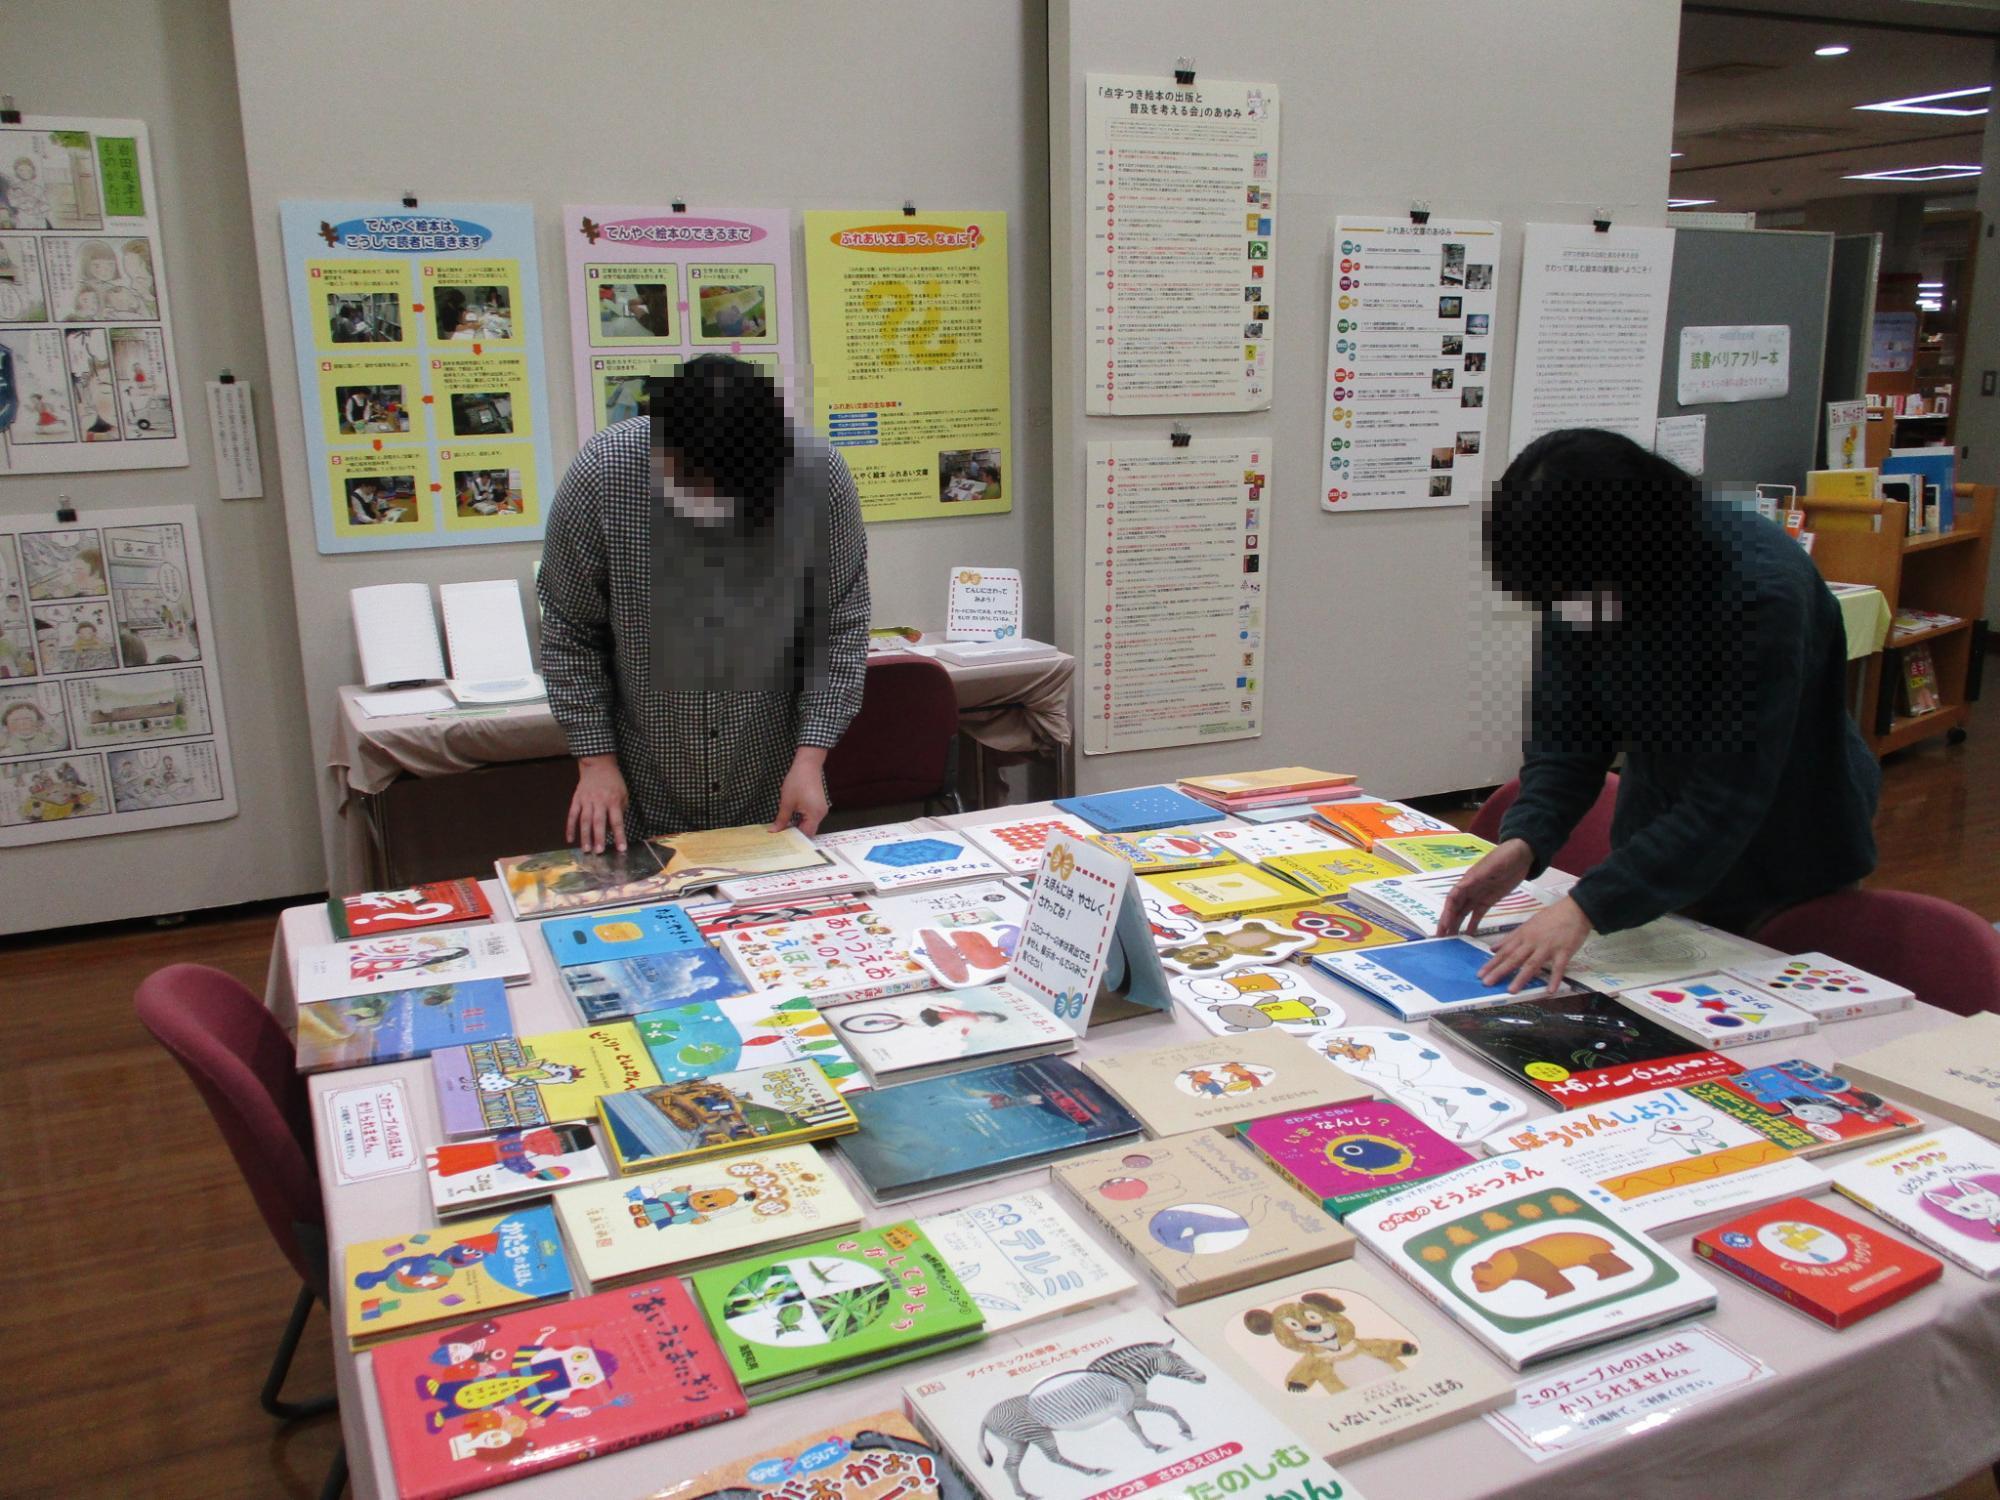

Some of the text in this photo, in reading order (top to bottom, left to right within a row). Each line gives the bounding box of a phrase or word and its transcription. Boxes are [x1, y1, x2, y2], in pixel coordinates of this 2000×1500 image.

[1099, 87, 1203, 103] 「点字つき絵本の出版と
[1130, 104, 1242, 118] 普及を考える会」のあゆみ
[365, 217, 459, 233] てんやく絵本は、
[606, 226, 751, 242] てんやく絵本のできるまで
[346, 235, 482, 250] こうして読者に届きます
[1690, 350, 1779, 370] 読書バリアフリー本
[853, 471, 886, 480] んやく絵本
[773, 937, 808, 979] えほん
[817, 946, 839, 959] の
[826, 914, 886, 980] あいうえお
[1550, 1050, 1727, 1096] あらしのよるに
[377, 1090, 404, 1160] このテーブルのほんは
[1316, 1117, 1371, 1130] なんじ
[1509, 1092, 1689, 1151] ぼうけんしよう!
[730, 1162, 784, 1217] まめ太郎
[1379, 1205, 1430, 1231] おかしの
[1430, 1167, 1545, 1210] どうぶつえん
[1000, 1228, 1084, 1296] テルミ
[1522, 1341, 1694, 1406] このテーブルのほんは
[918, 1382, 945, 1397] DK
[1558, 1365, 1693, 1416] かりられません。
